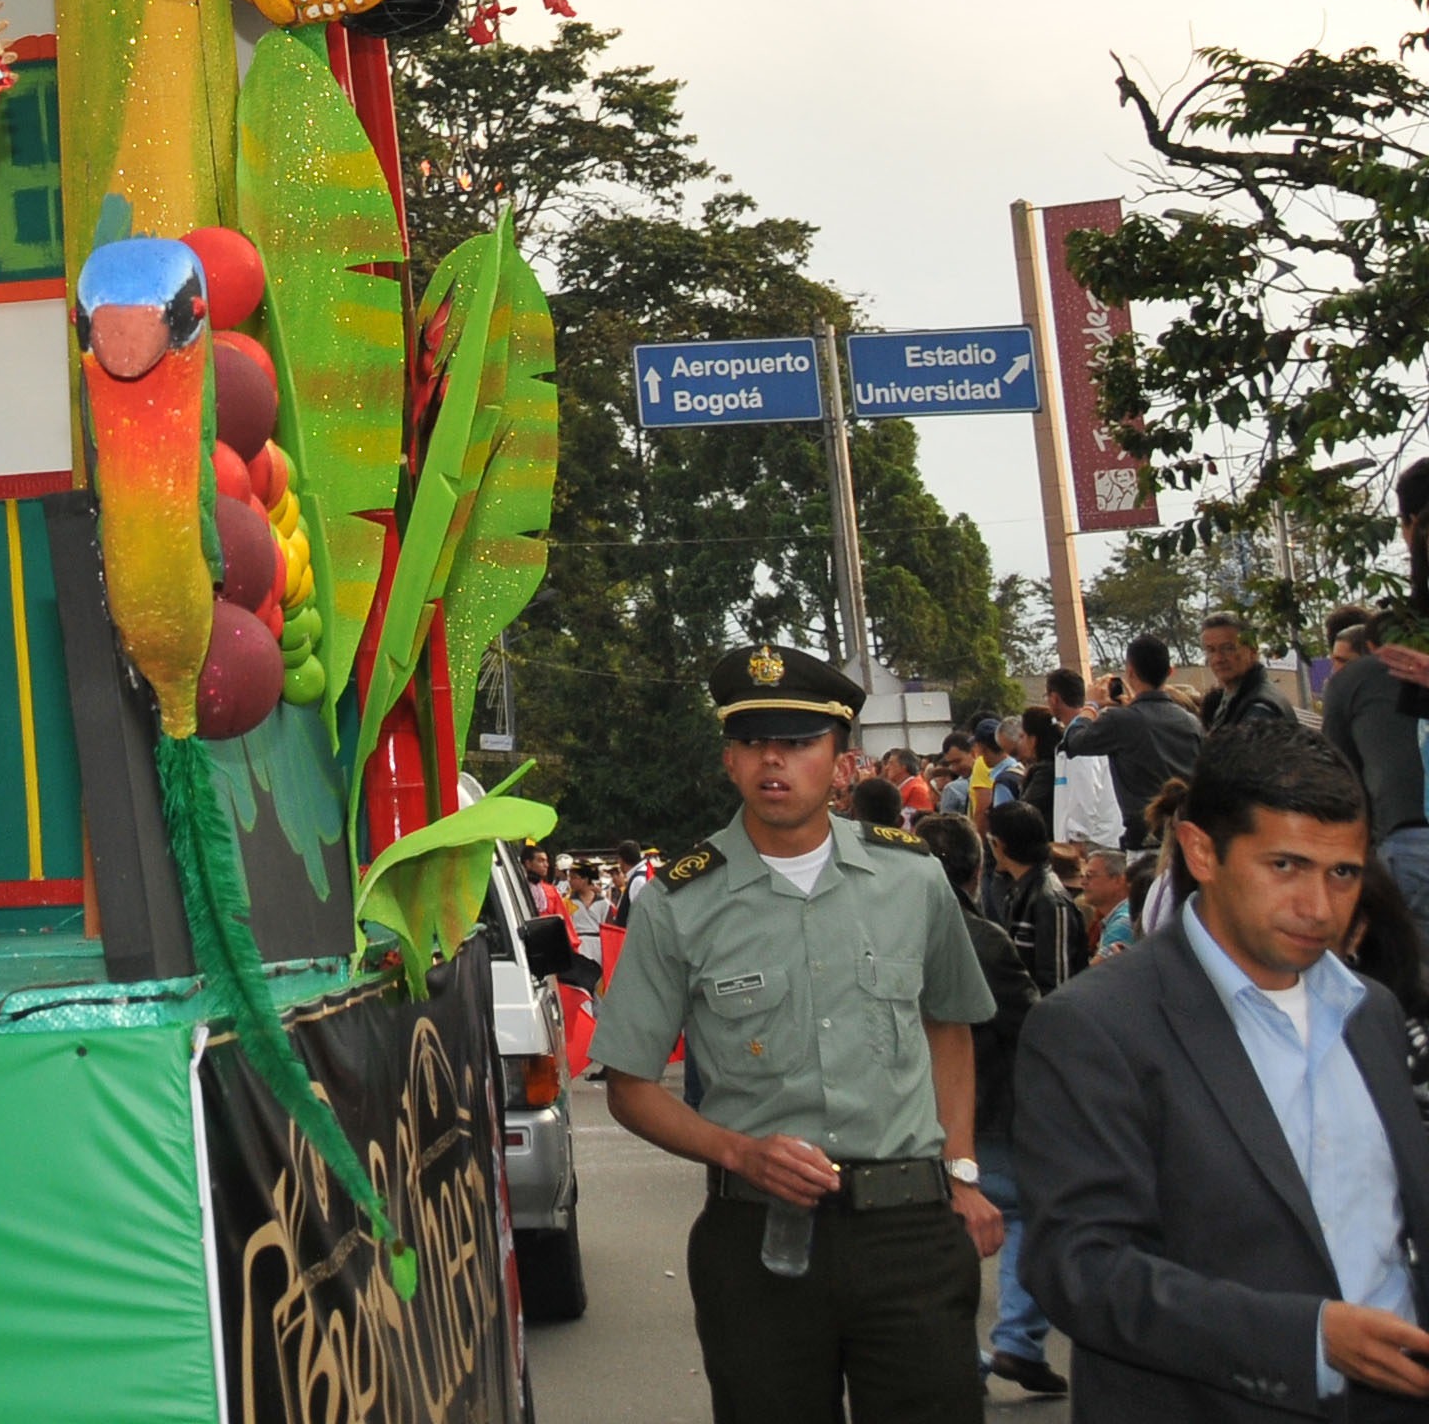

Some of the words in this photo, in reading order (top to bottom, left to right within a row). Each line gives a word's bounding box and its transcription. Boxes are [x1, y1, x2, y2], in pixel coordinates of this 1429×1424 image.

[671, 351, 810, 380] Aeropuerto
[904, 344, 996, 368] Estadio
[673, 386, 763, 416] Bogotá
[855, 378, 1001, 405] Universidad
